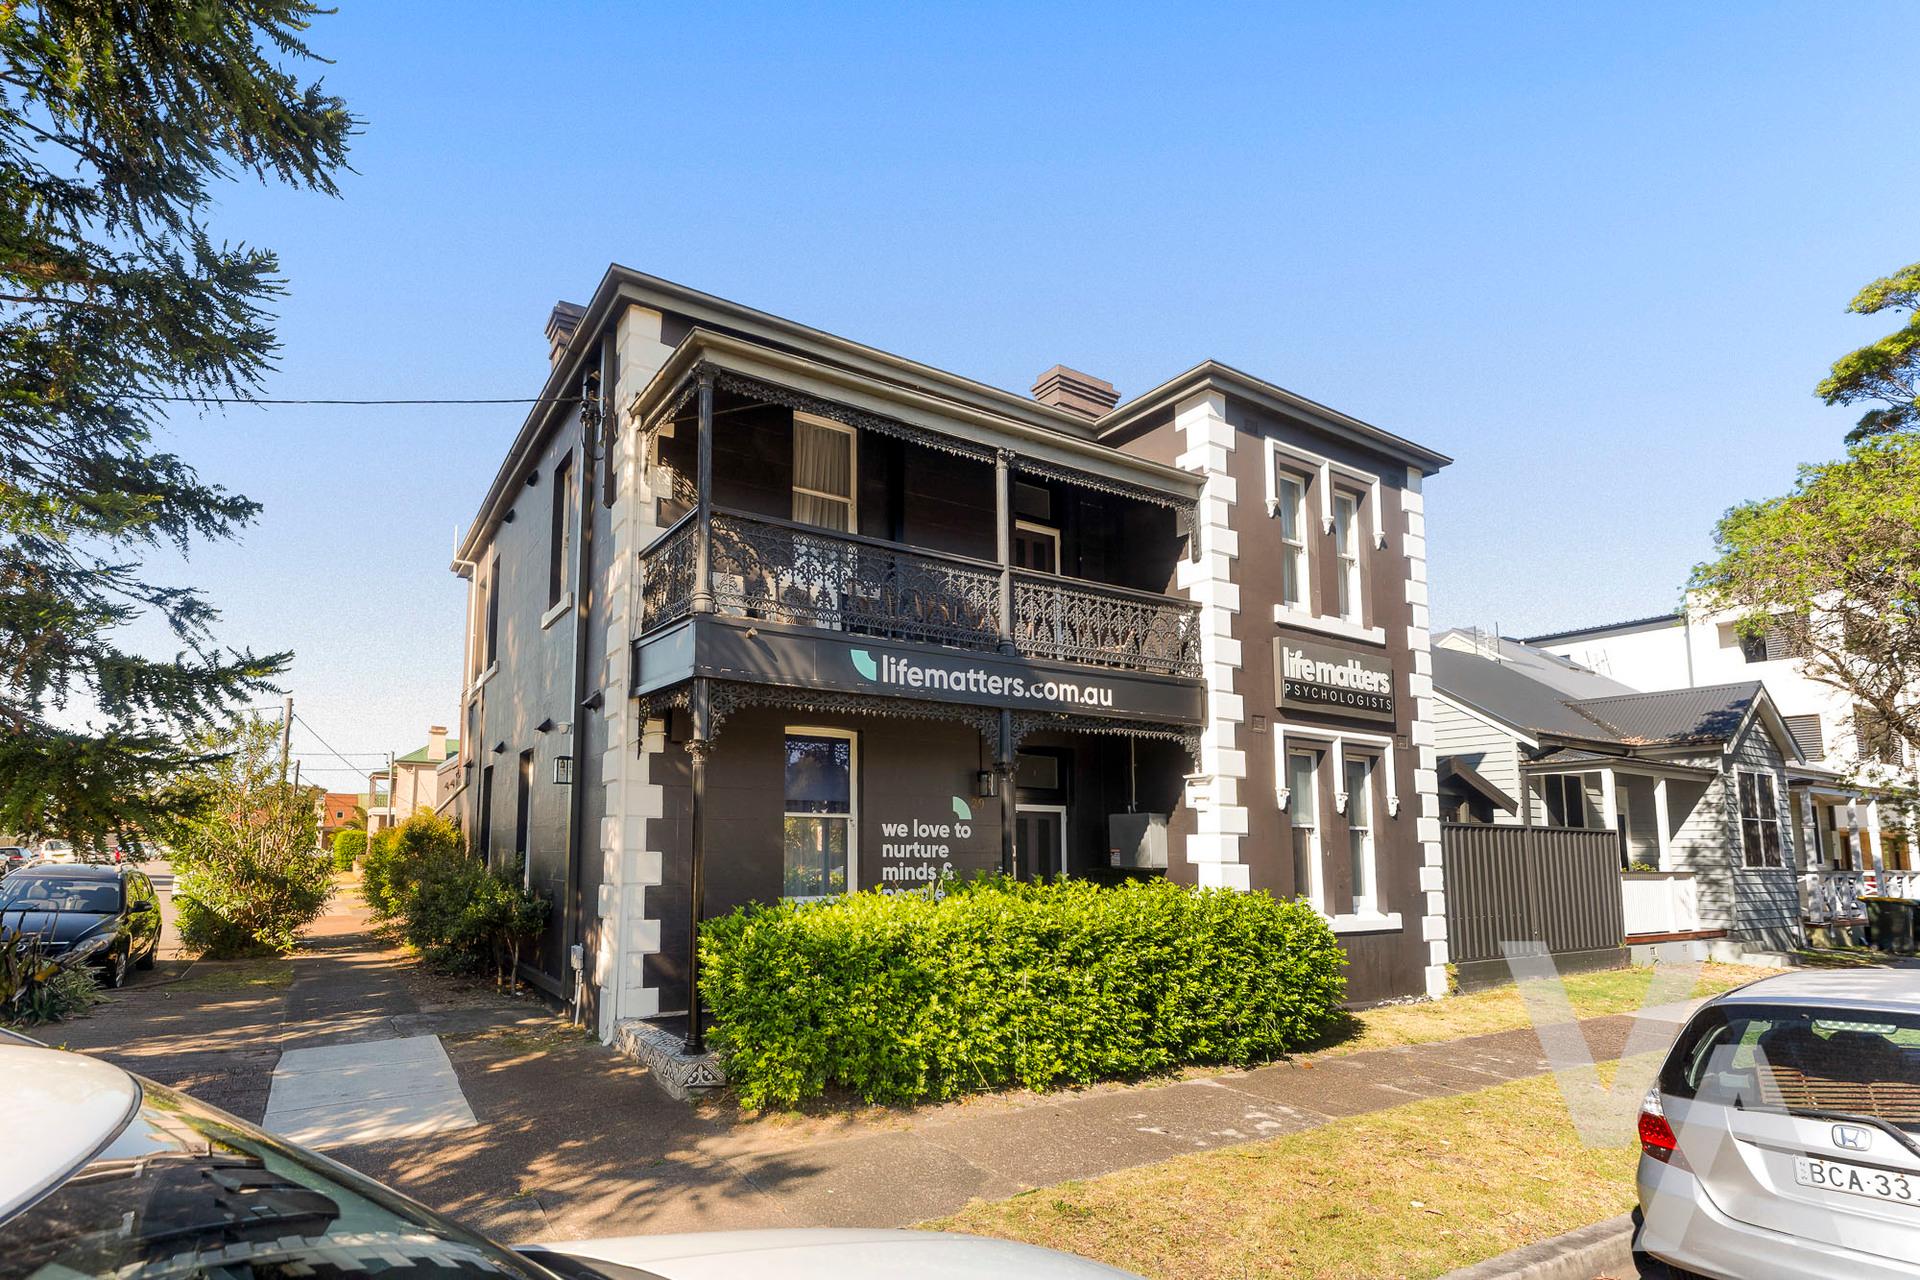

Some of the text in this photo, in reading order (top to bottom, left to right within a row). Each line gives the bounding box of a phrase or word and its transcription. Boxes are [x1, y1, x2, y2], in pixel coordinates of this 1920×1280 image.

[882, 654, 1113, 707] lifematters.com.au
[1284, 683, 1392, 711] PSYCHOLOGISTS
[882, 819, 972, 839] we love to
[882, 842, 949, 858] nurture
[882, 861, 937, 880] minds
